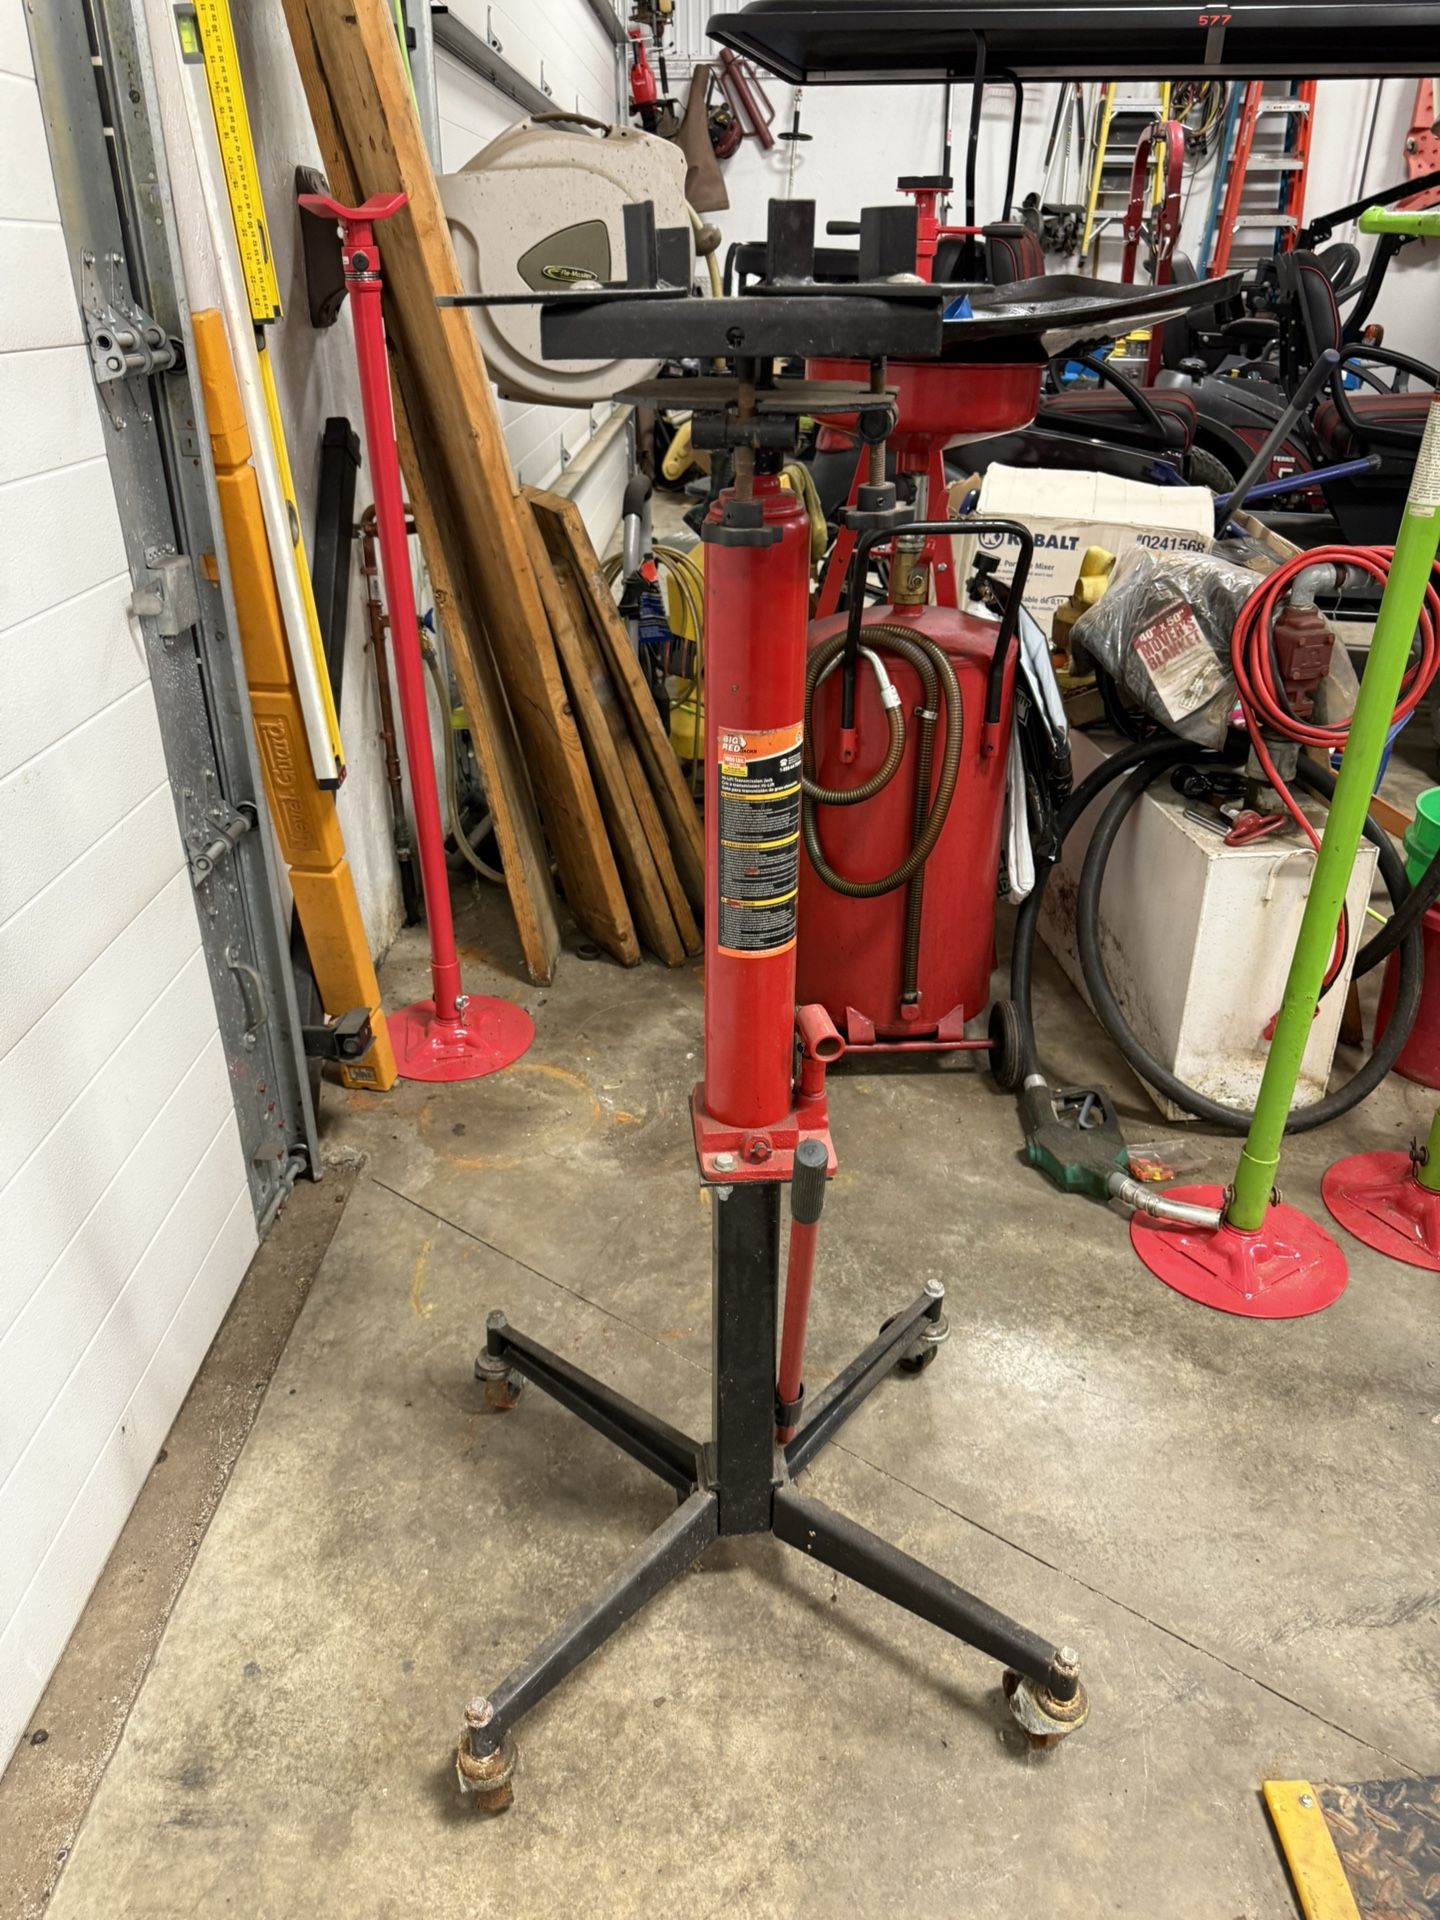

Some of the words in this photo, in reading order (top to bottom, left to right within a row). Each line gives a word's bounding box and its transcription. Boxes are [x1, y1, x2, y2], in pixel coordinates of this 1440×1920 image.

[1199, 14, 1231, 26] 577
[1007, 533, 1079, 551] KBALT
[1035, 562, 1055, 570] Mixer
[1140, 617, 1196, 659] MOVER'S
[723, 735, 738, 744] BIG
[260, 718, 296, 785] Guard
[722, 744, 740, 752] RED
